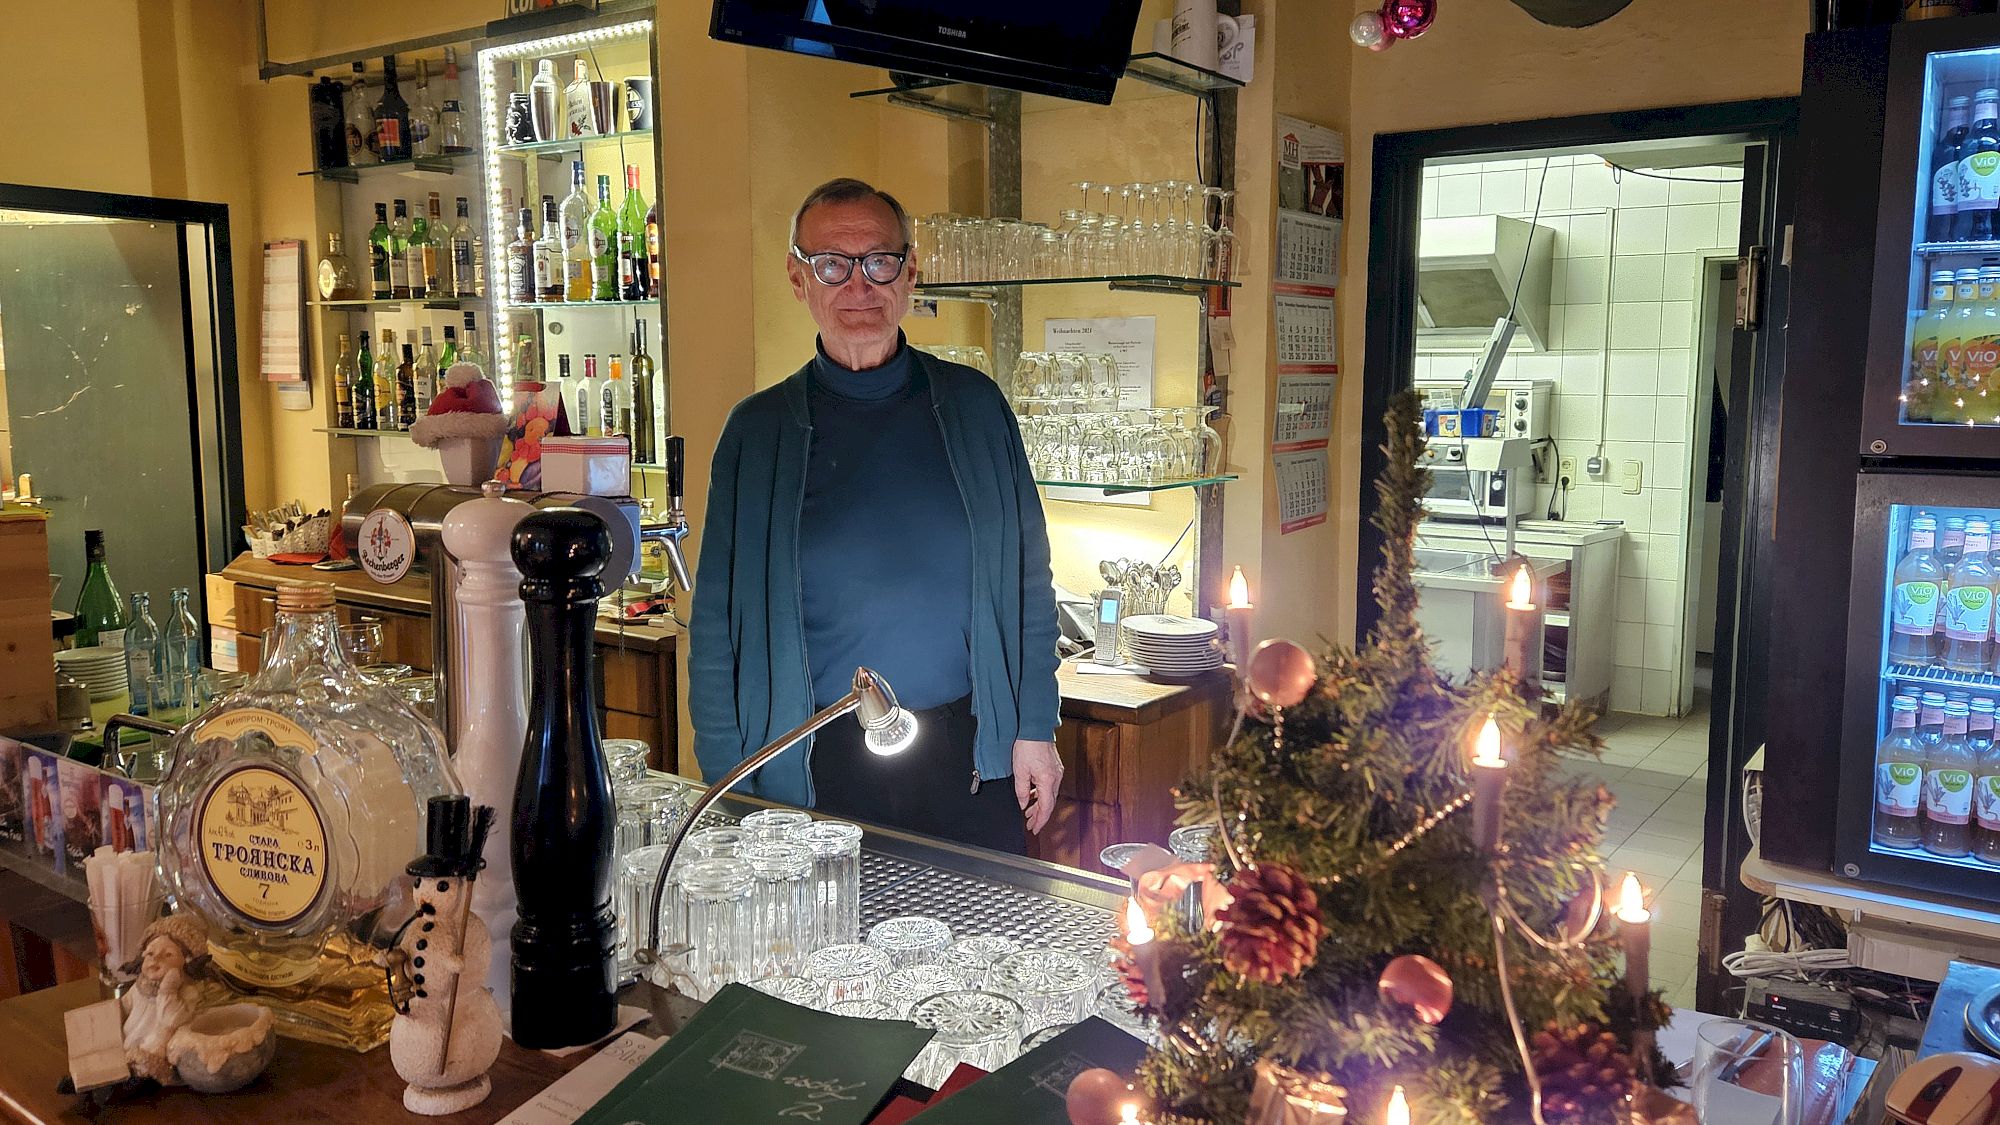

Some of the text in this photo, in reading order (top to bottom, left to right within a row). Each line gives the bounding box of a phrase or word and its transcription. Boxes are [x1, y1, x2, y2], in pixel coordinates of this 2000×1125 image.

[938, 25, 967, 39] TOSHIBA
[1283, 139, 1299, 156] MH
[1974, 156, 1997, 166] ViO
[1922, 350, 1938, 361] Vi
[1967, 350, 1997, 363] ViO
[362, 549, 405, 572] Rechenberger
[1911, 586, 1933, 596] ViO
[1963, 591, 1986, 600] ViO
[1893, 766, 1915, 776] ViO
[1943, 773, 1966, 783] ViO
[249, 834, 281, 849] СТАРА
[212, 842, 317, 877] ТРОЯНСКА
[239, 866, 290, 886] СЛИВОВА
[258, 882, 270, 899] 7
